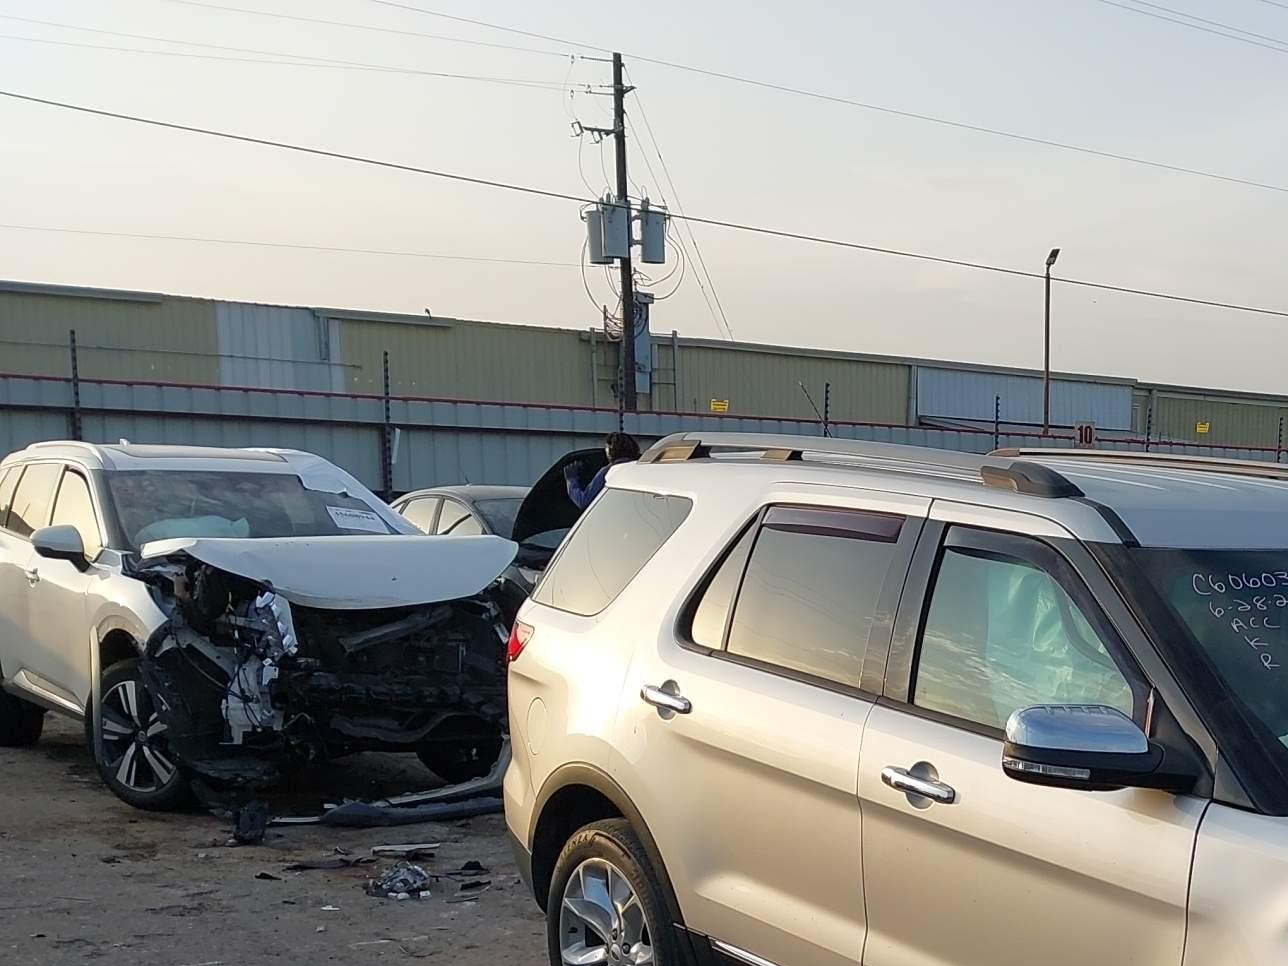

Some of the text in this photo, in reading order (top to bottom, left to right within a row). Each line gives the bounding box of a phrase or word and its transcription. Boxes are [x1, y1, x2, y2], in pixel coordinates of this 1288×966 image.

[1078, 425, 1093, 445] 10
[1230, 616, 1281, 633] ACC
[1260, 652, 1281, 670] R
